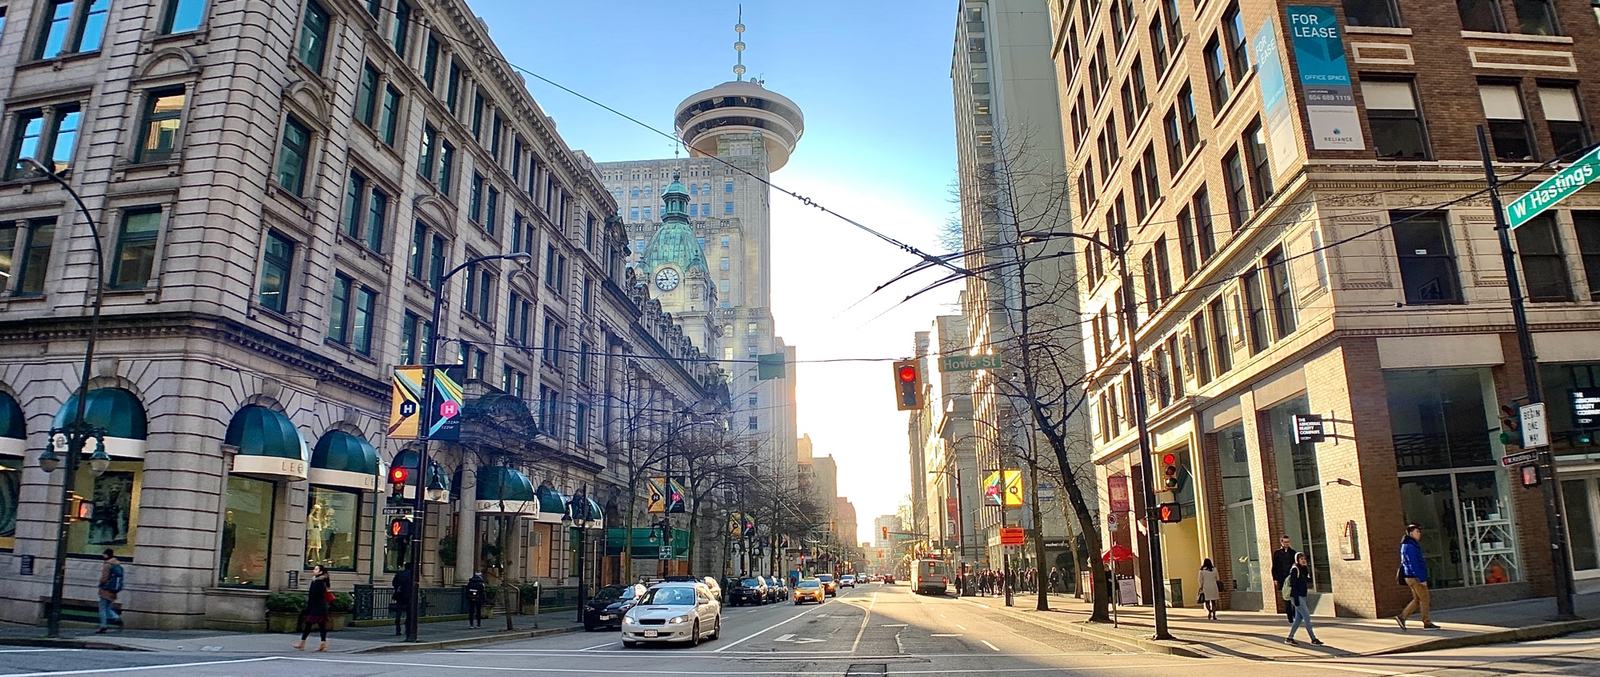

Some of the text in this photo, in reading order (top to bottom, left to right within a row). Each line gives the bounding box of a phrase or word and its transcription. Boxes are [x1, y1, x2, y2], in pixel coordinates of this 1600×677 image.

[1291, 14, 1318, 25] FOR
[1294, 27, 1337, 38] LEASE
[1513, 163, 1593, 219] W Hastings
[944, 355, 996, 369] Howe St
[403, 404, 413, 414] H
[444, 405, 454, 414] H
[1523, 408, 1540, 421] BEGIN
[1527, 421, 1538, 431] ONE
[1528, 433, 1539, 445] WAY
